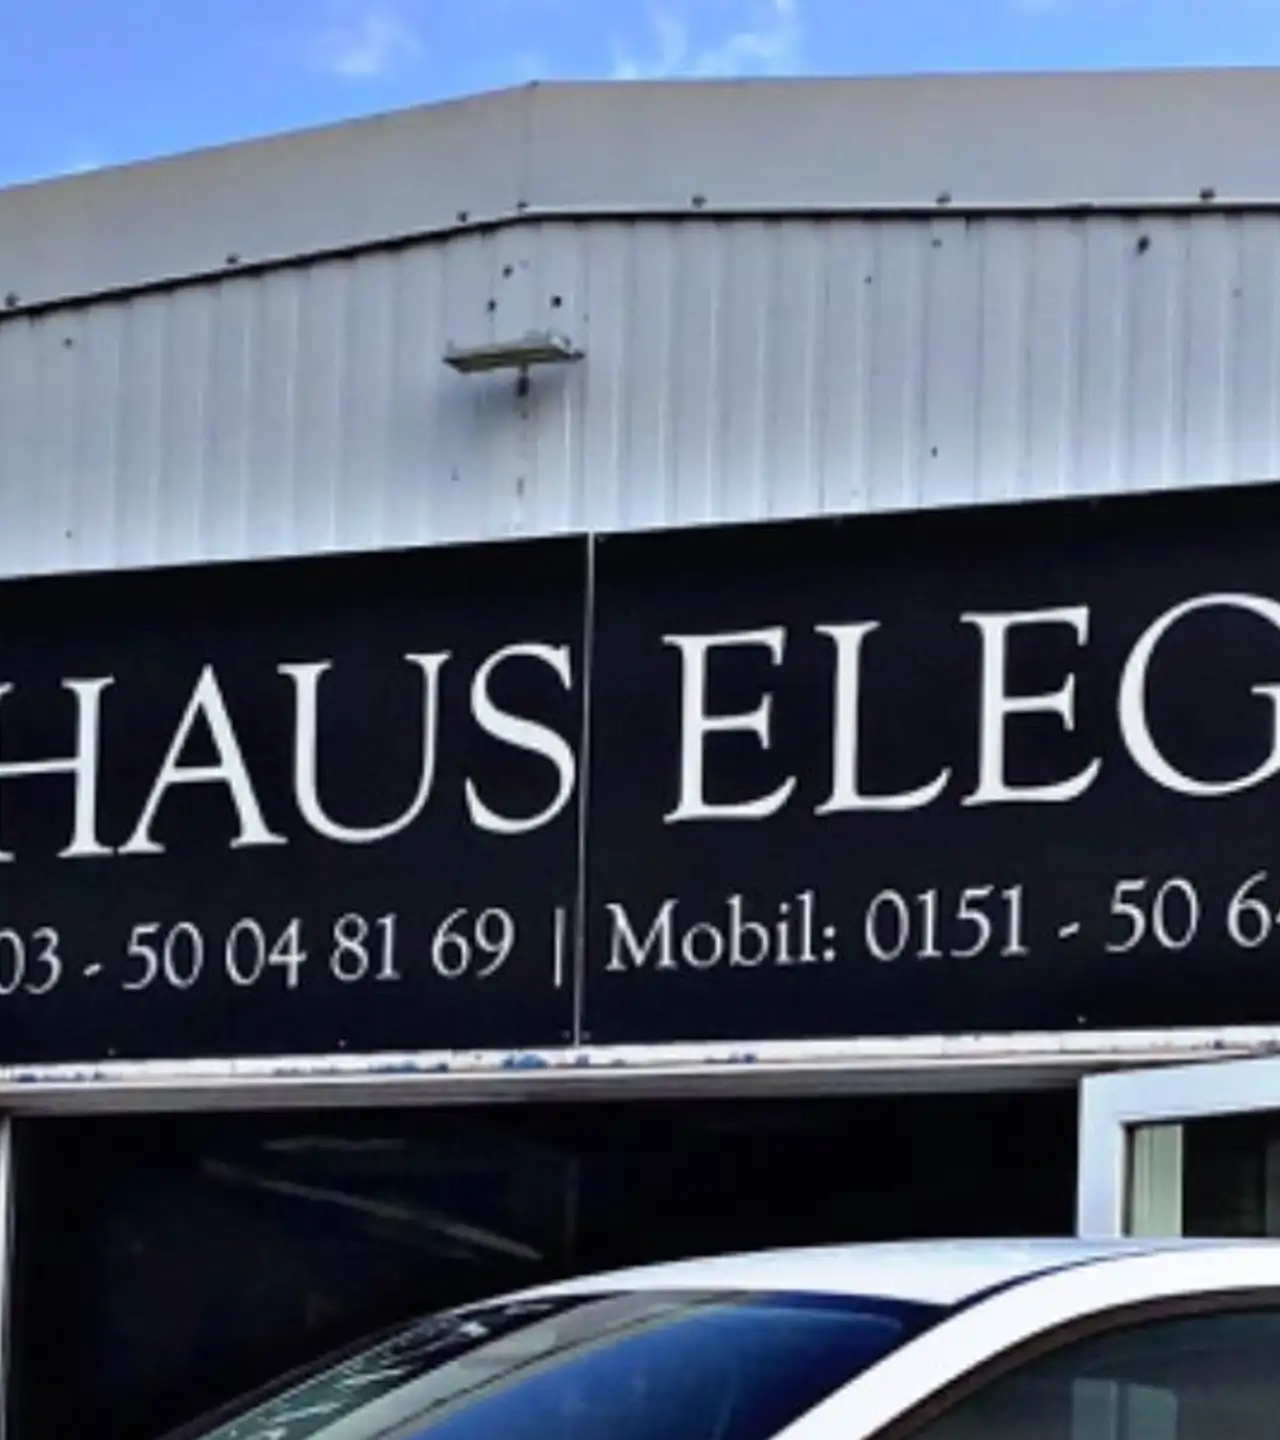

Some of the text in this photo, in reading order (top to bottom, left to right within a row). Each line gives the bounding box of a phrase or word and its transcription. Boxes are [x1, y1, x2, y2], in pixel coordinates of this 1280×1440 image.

[122, 920, 205, 991] 50
[224, 916, 308, 989] 04
[329, 911, 404, 982] 81
[430, 906, 516, 977] 69
[605, 890, 838, 972] Mobil:
[864, 883, 1032, 963] 0151
[1105, 877, 1200, 954] 50
